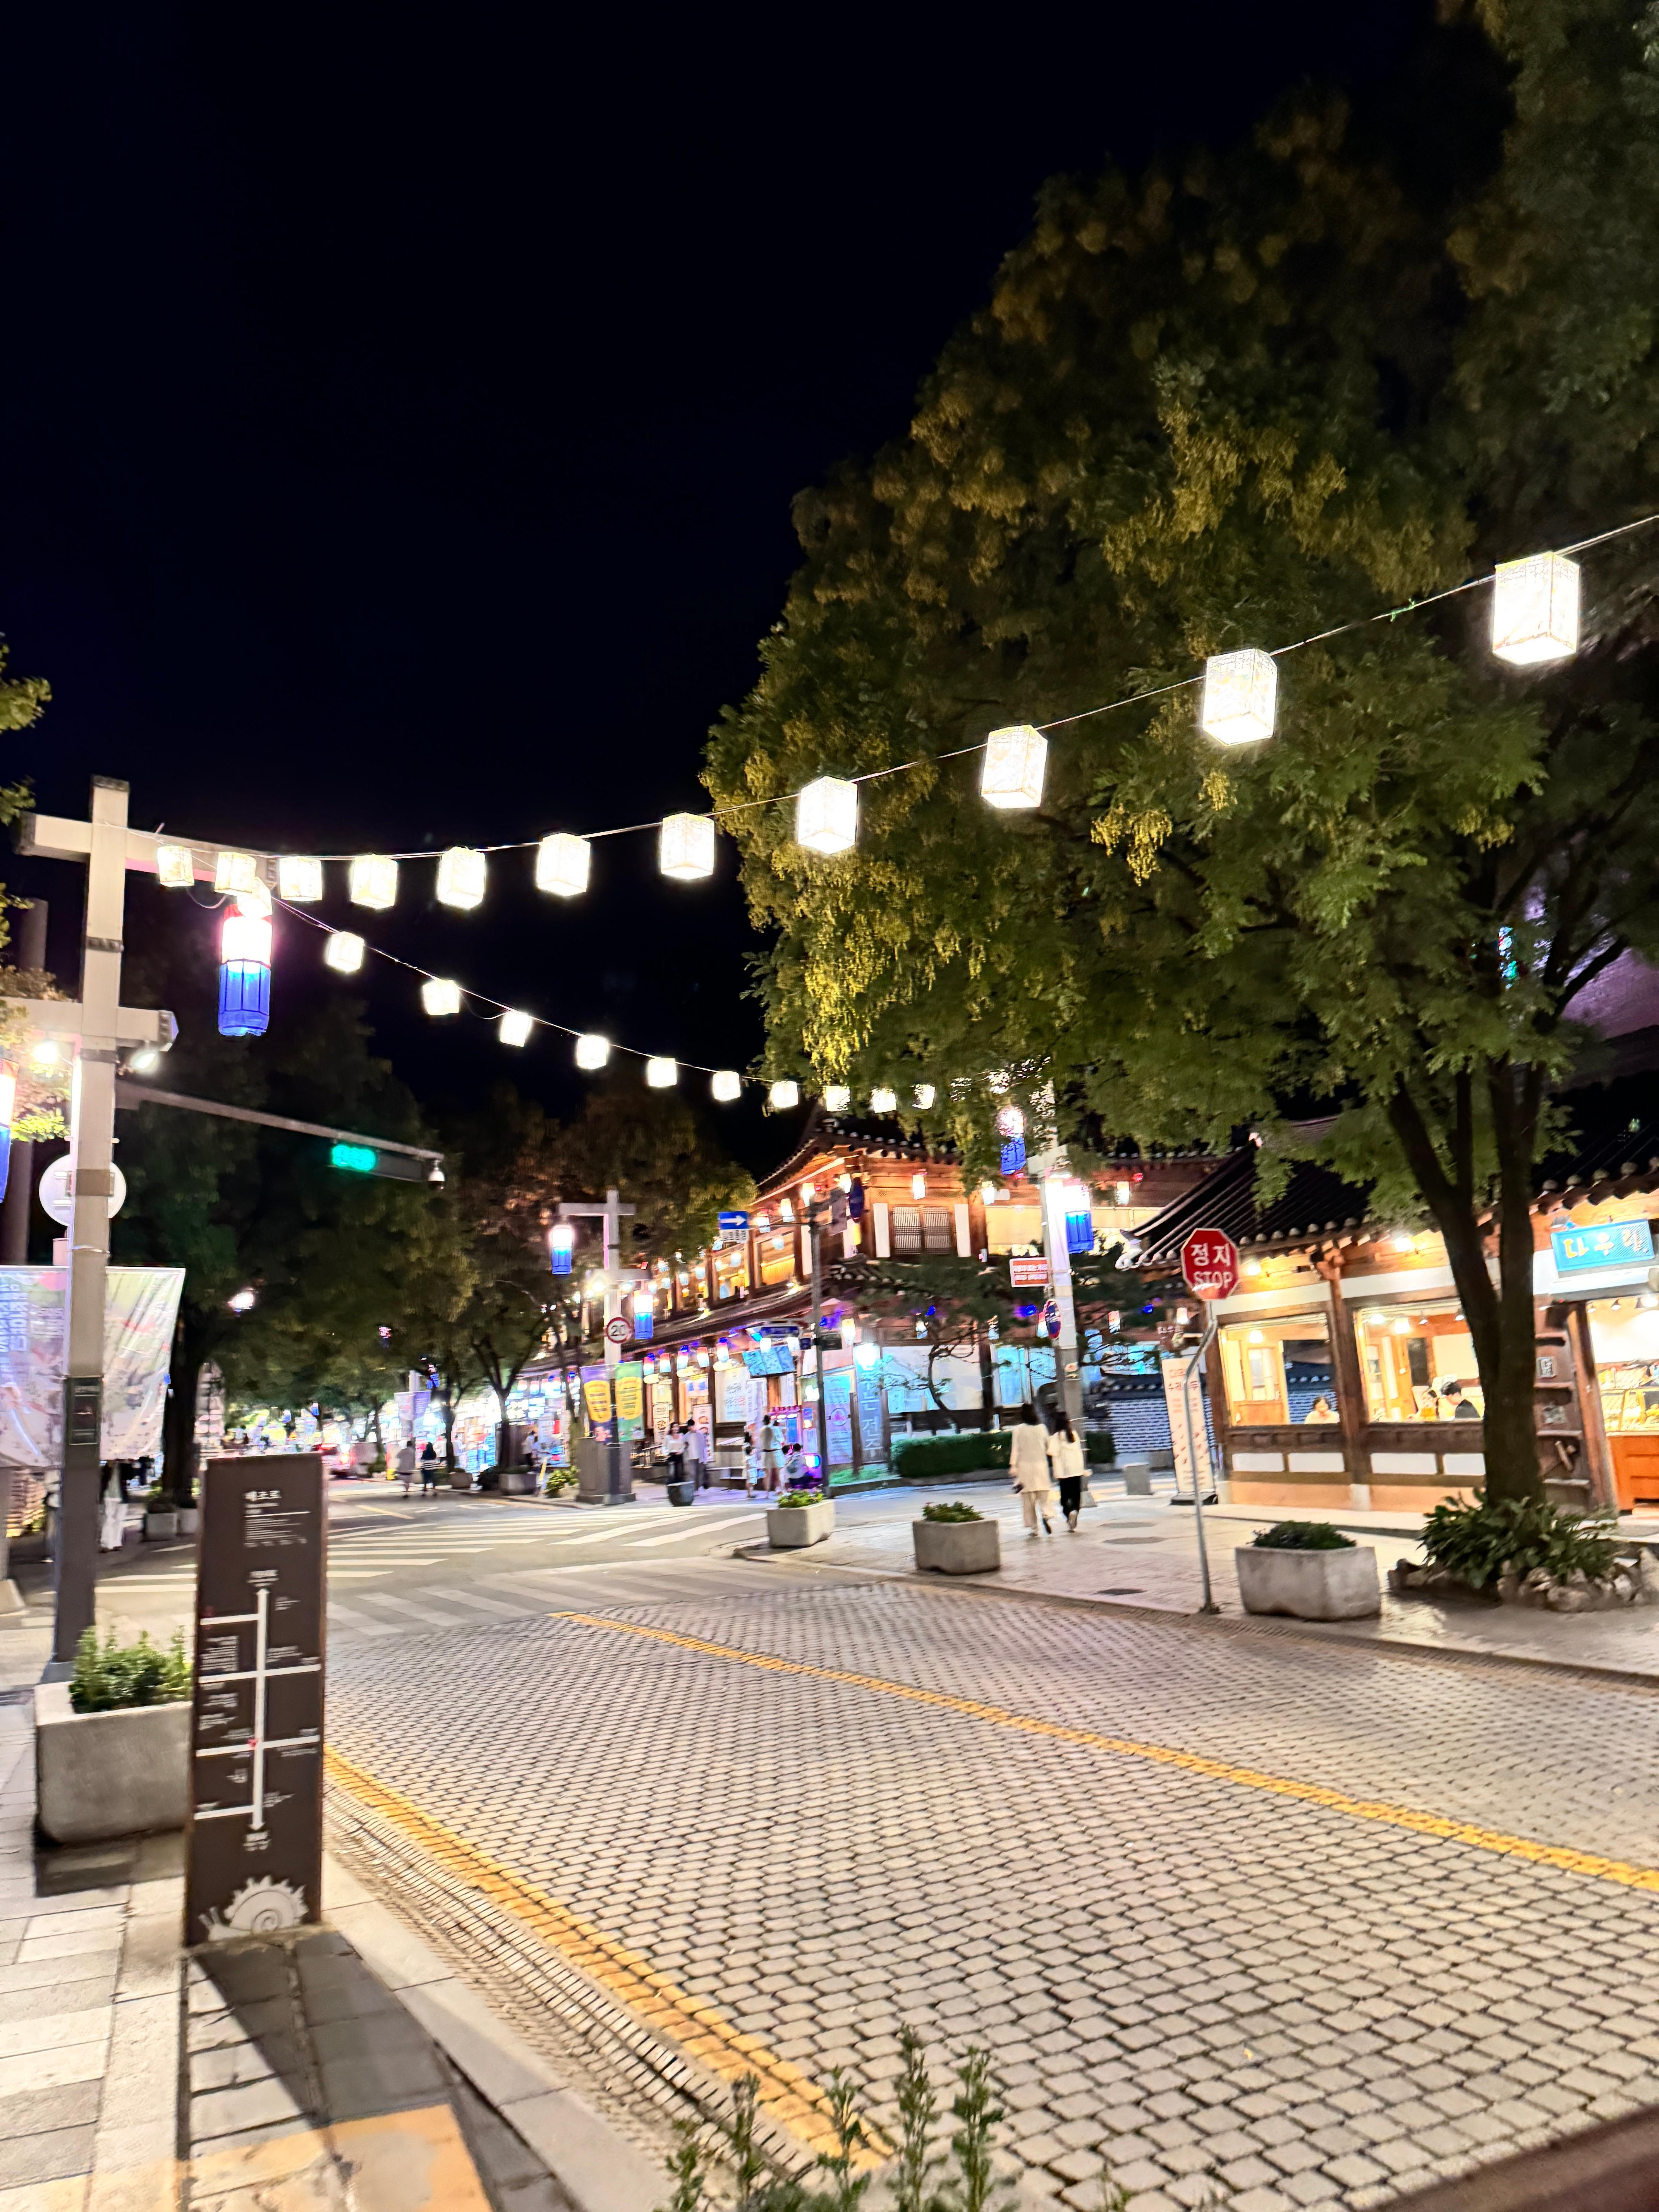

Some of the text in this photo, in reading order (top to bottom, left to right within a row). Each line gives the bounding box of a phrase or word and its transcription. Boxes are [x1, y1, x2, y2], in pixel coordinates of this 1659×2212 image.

[1190, 1242, 1231, 1266] 정지
[1193, 1271, 1233, 1288] STOP
[611, 1326, 626, 1336] 20
[862, 1416, 883, 1457] 전주
